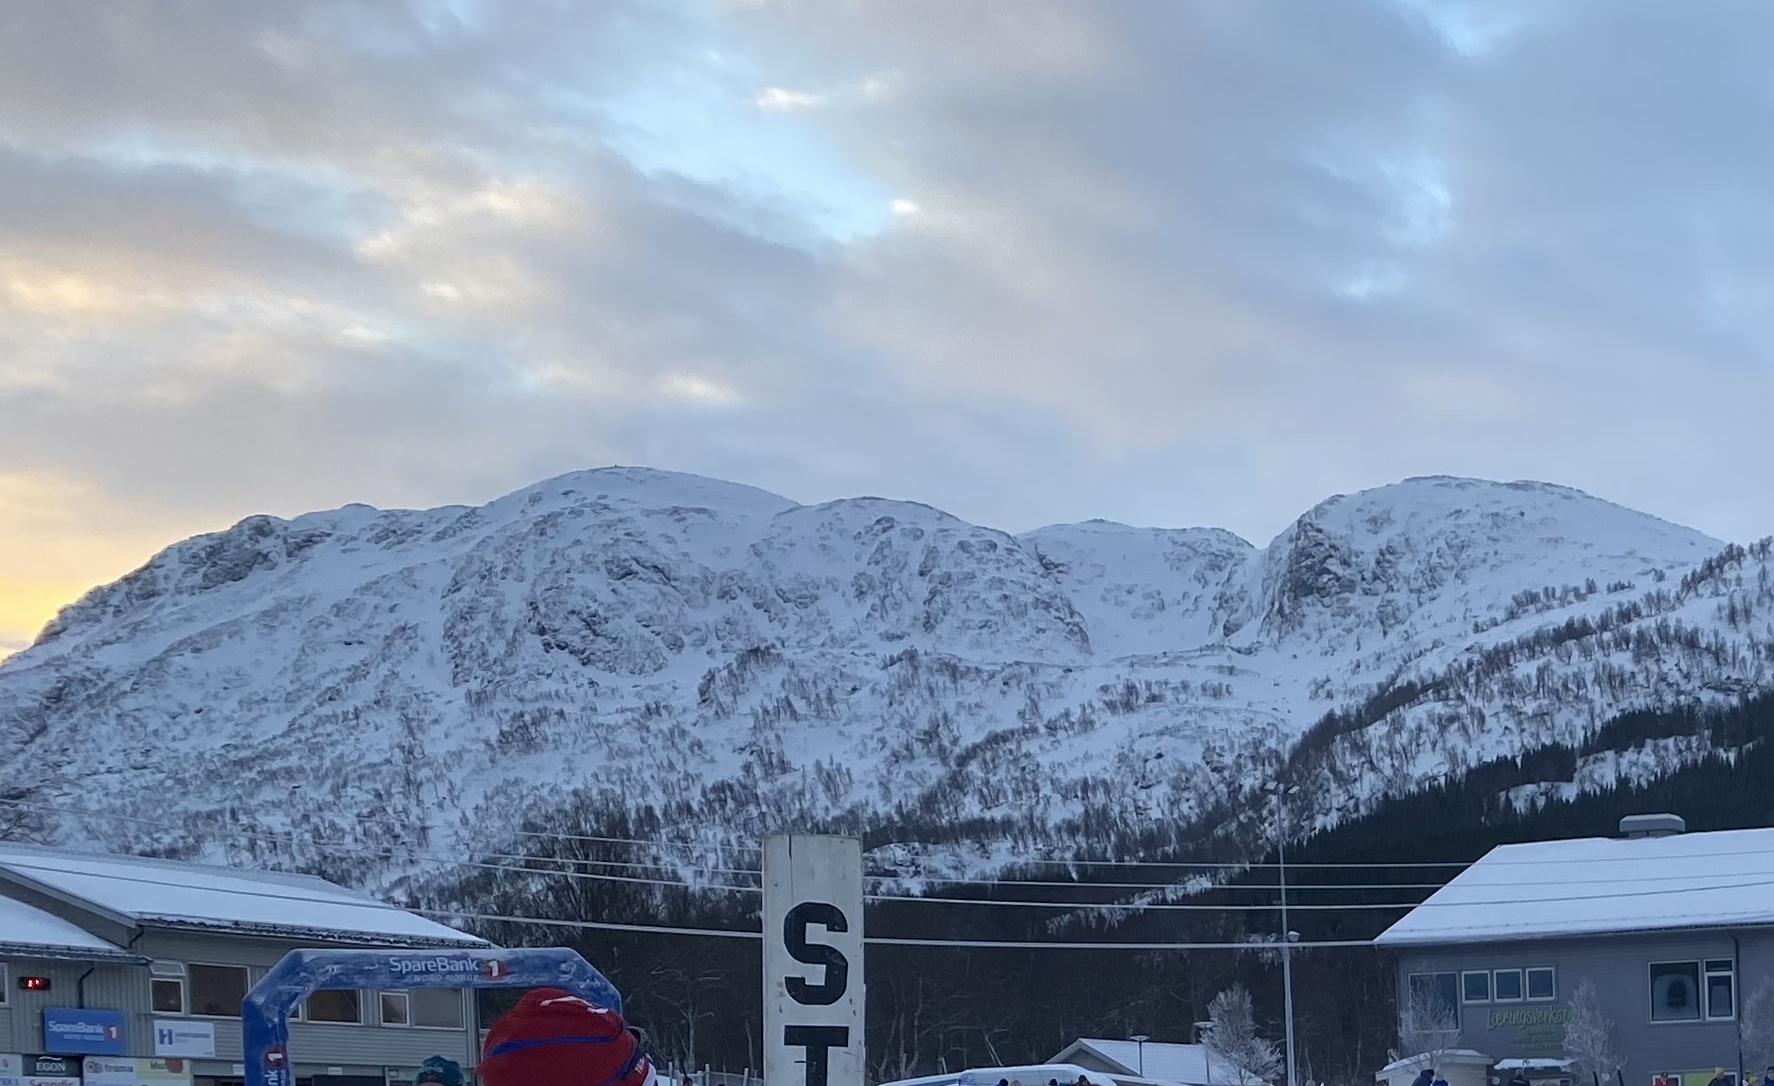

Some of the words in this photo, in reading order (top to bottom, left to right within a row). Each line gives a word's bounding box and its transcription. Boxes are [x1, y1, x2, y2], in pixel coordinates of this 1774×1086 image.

[389, 956, 479, 975] SpareBank
[487, 960, 499, 977] 1
[48, 1020, 105, 1034] SpareBank
[109, 1026, 117, 1039] 1
[35, 1062, 66, 1072] EGON
